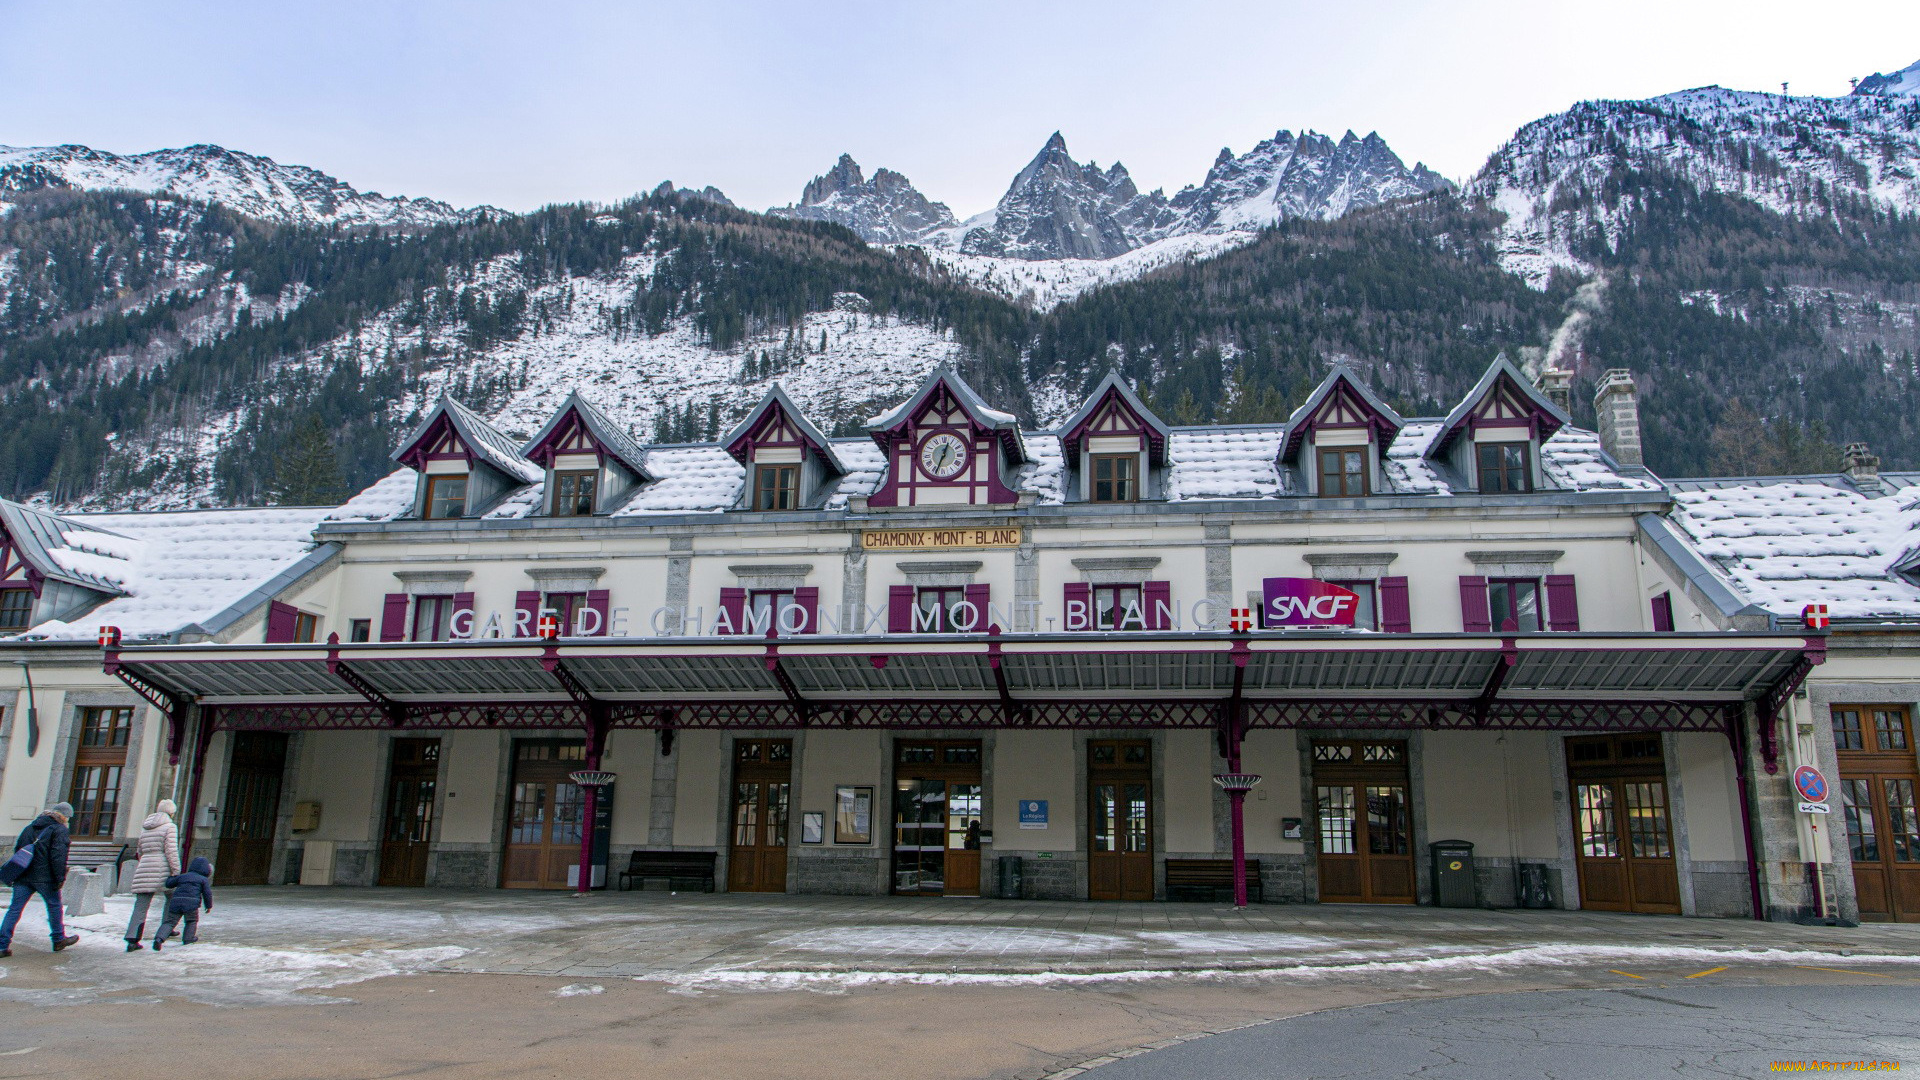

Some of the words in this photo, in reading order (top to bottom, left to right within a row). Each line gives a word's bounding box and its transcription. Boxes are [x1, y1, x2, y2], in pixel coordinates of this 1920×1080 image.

[865, 531, 925, 547] CHAMONIX
[933, 531, 967, 546] MONT
[975, 530, 1017, 545] BLANC
[576, 607, 629, 636] DE
[650, 602, 888, 634] CHAMONIX
[1268, 595, 1353, 620] SNCF
